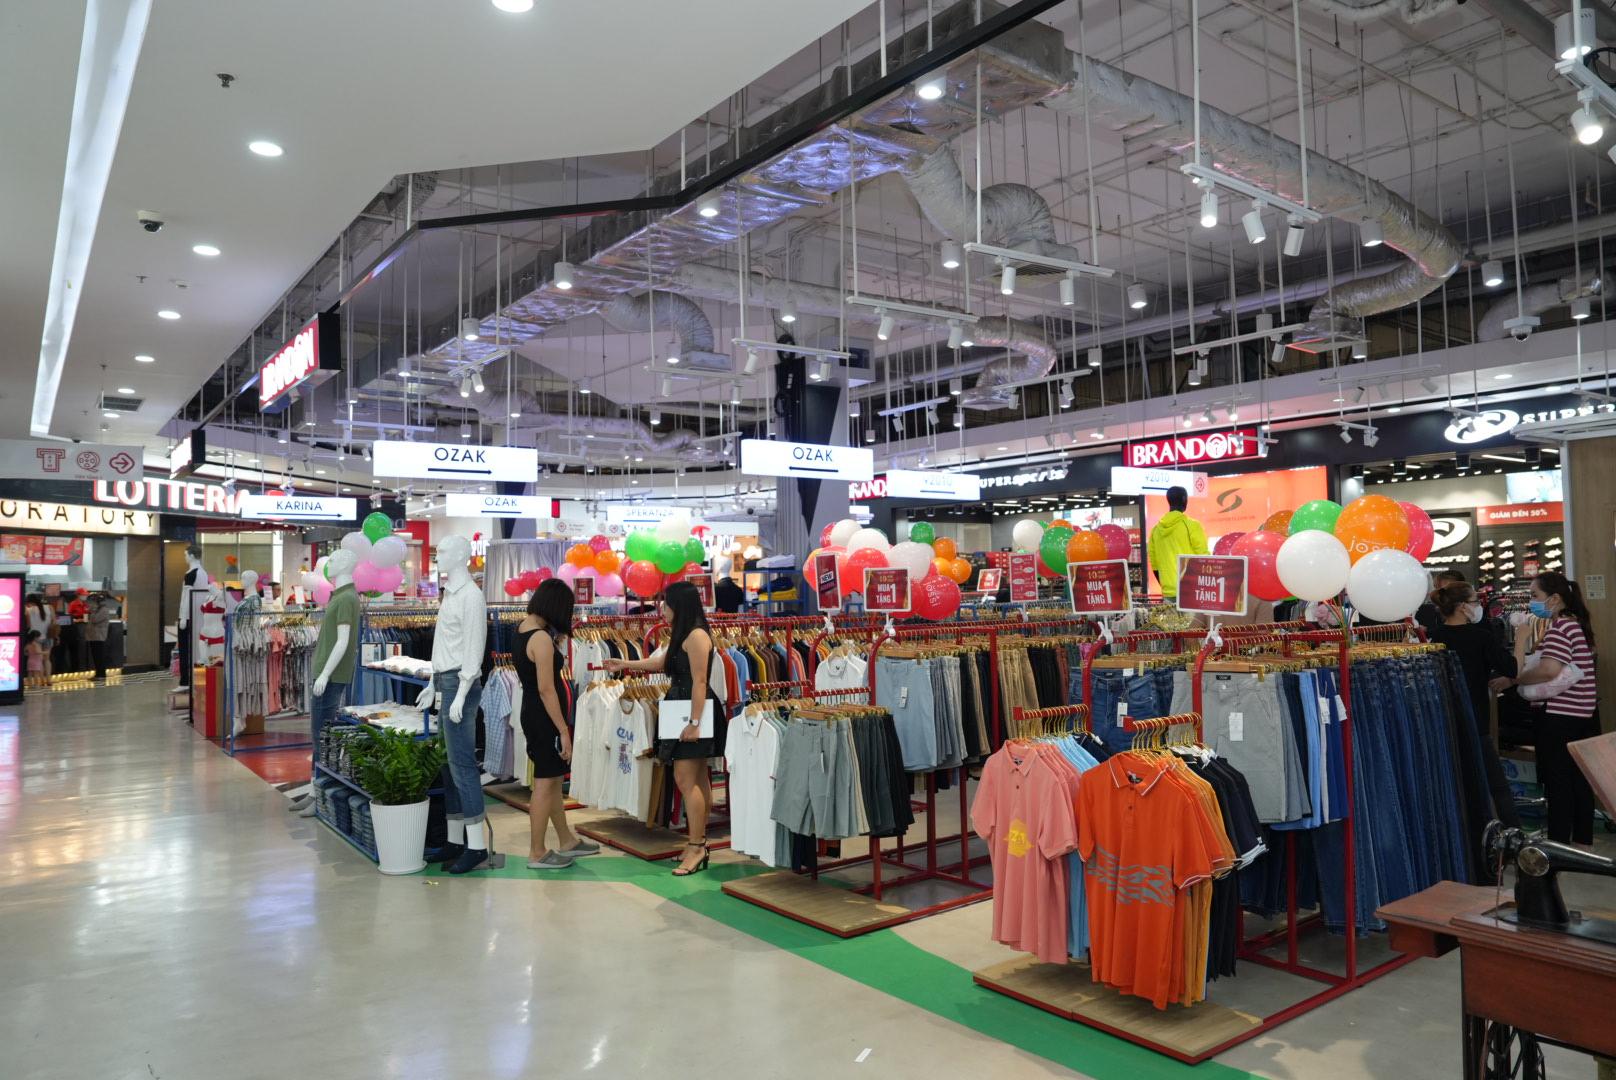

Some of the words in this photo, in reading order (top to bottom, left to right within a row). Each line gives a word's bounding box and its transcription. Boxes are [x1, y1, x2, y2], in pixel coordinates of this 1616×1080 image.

[434, 447, 486, 463] OZAK
[793, 446, 833, 462] OZAK
[1132, 432, 1244, 466] BRANDON
[276, 501, 323, 511] KARINA
[484, 496, 518, 507] OZAK
[1530, 508, 1548, 517] 50%
[821, 572, 833, 582] NEW
[1087, 581, 1103, 590] MUA
[1103, 580, 1112, 604] 1
[1198, 576, 1216, 586] MUA
[1217, 577, 1225, 602] 1
